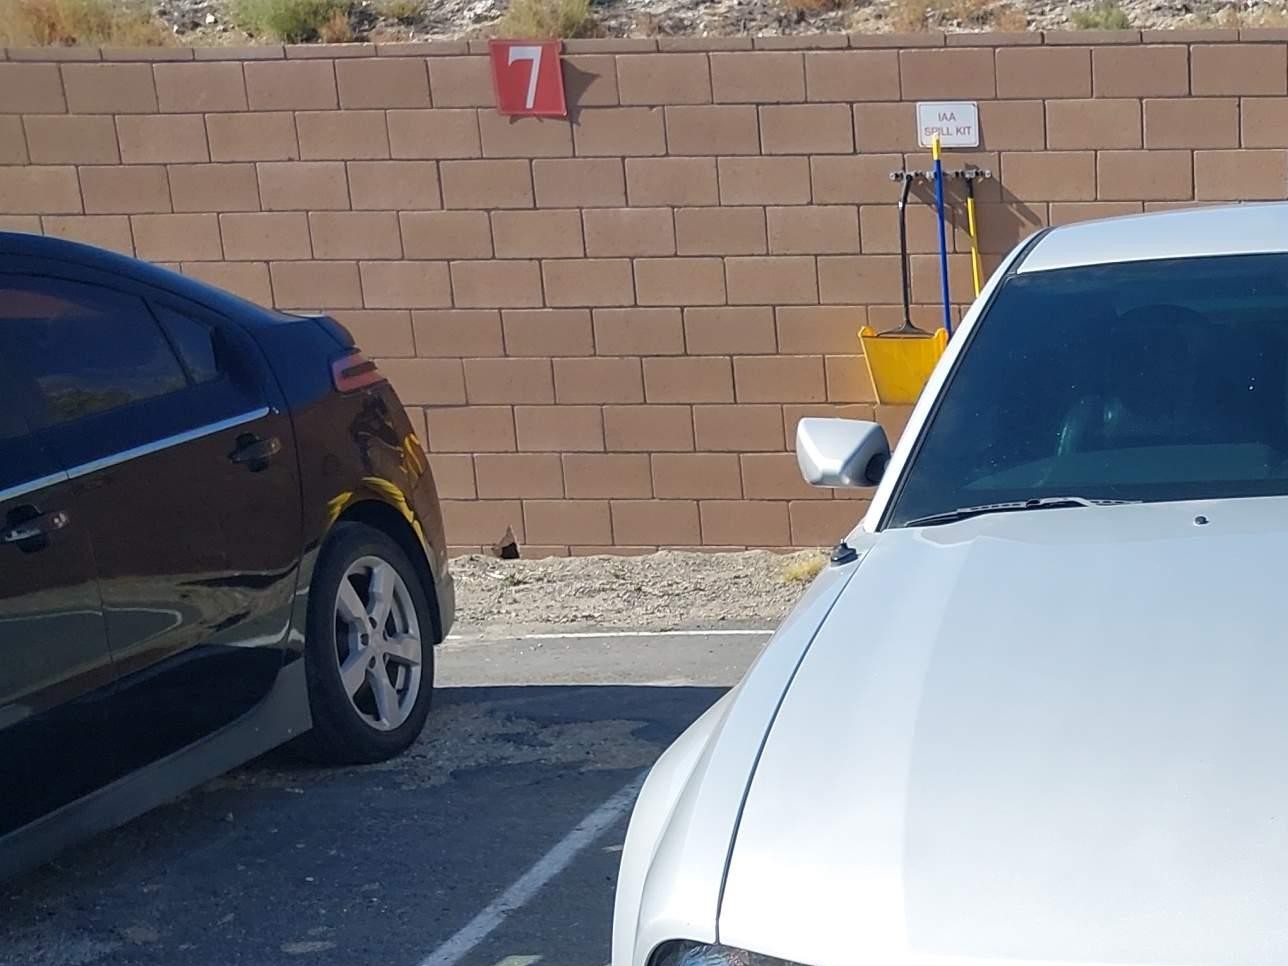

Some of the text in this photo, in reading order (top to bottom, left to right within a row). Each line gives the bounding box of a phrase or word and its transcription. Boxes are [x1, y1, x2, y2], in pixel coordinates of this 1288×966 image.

[508, 46, 543, 109] 7
[937, 112, 957, 122] IAA
[955, 126, 972, 137] KIT
